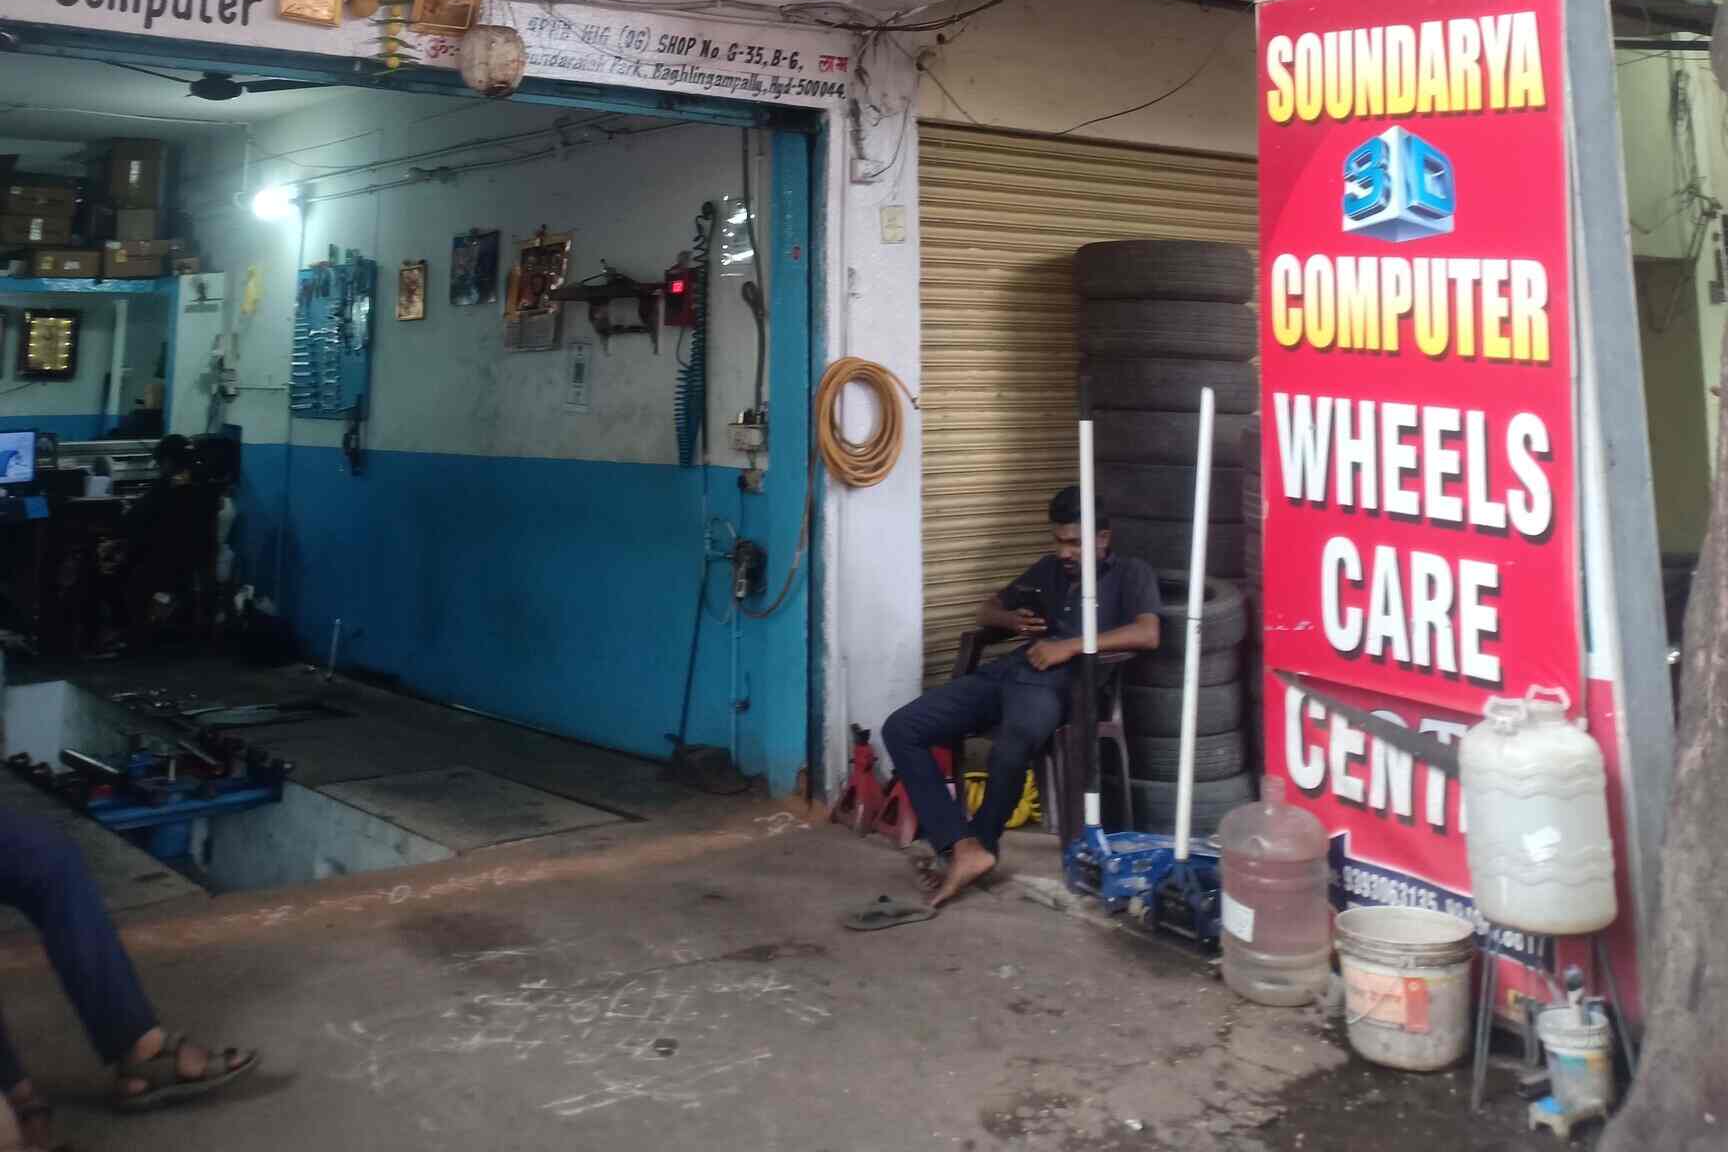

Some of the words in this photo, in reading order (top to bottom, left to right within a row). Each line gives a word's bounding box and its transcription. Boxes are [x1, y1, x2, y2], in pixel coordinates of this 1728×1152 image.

[656, 33, 697, 57] SHOP
[701, 37, 720, 58] No
[1266, 11, 1547, 123] SOUNDARYA
[1342, 134, 1455, 222] 3D
[1271, 253, 1551, 362] COMPUTER
[1273, 392, 1552, 537] WHEELS
[1319, 536, 1504, 684] CARE
[1285, 685, 1467, 834] CENT
